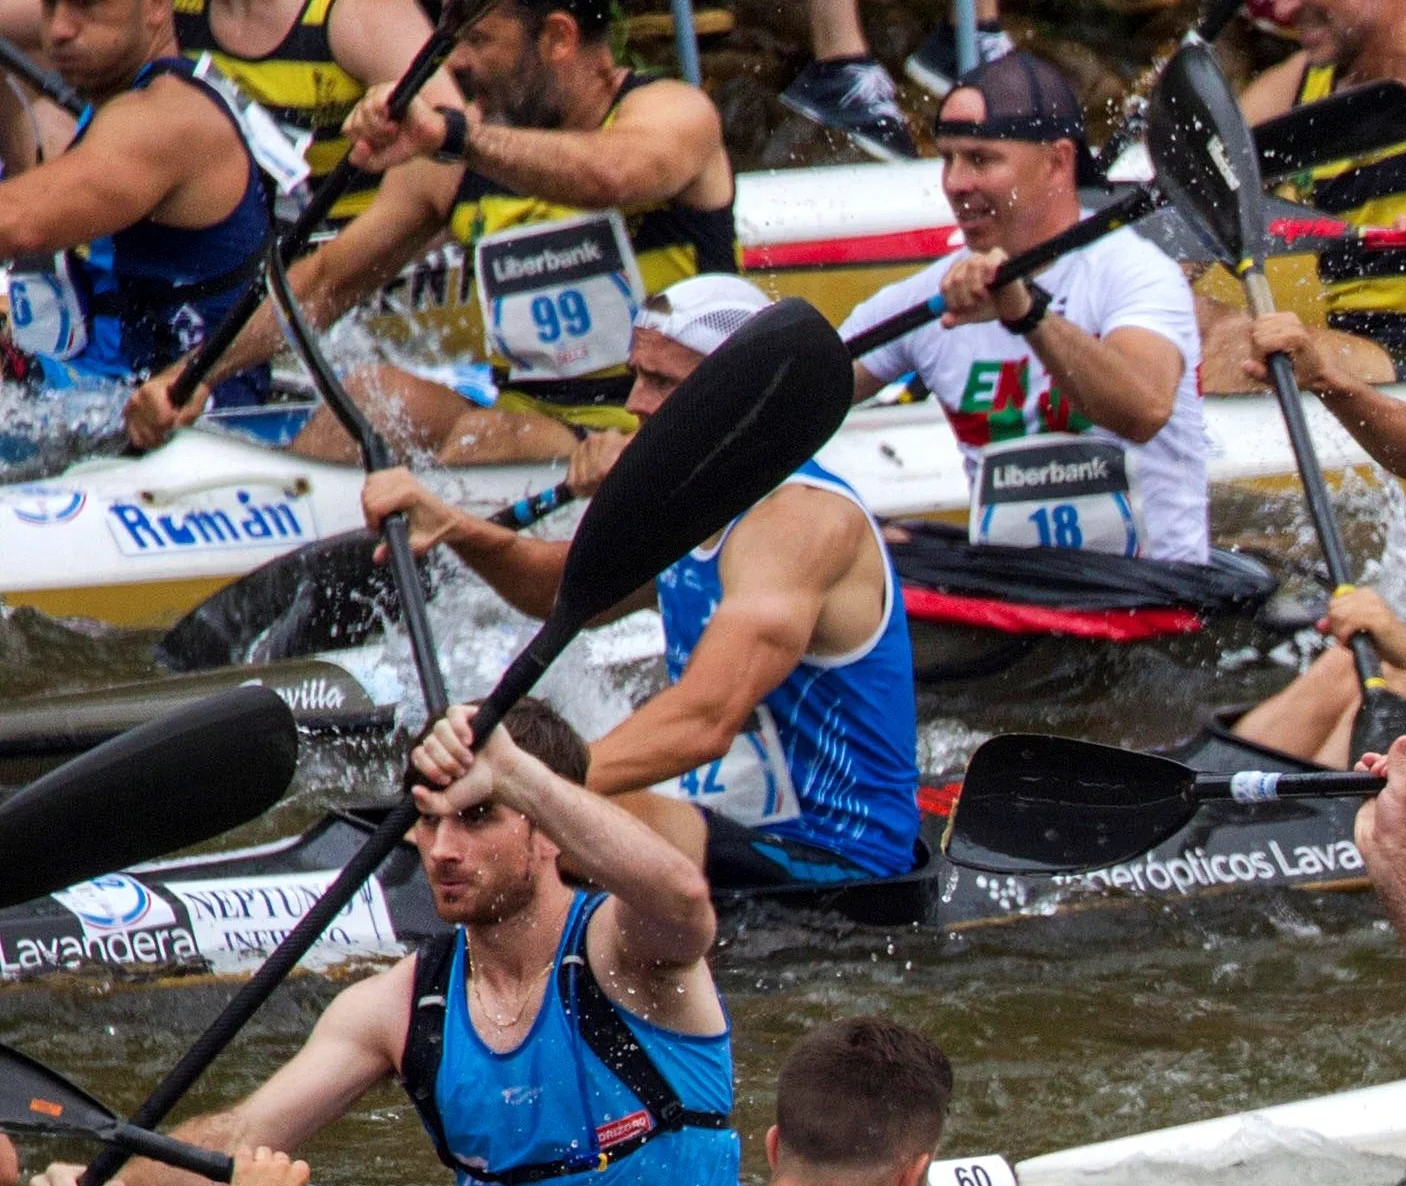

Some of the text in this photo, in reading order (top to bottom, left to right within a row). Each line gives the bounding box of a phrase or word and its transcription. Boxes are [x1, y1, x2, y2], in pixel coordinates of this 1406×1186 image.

[492, 237, 602, 283] Liberbank
[532, 289, 592, 344] 99
[994, 467, 1111, 491] Liberbank
[1028, 504, 1084, 549] 18
[0, 926, 199, 970] Lavandera
